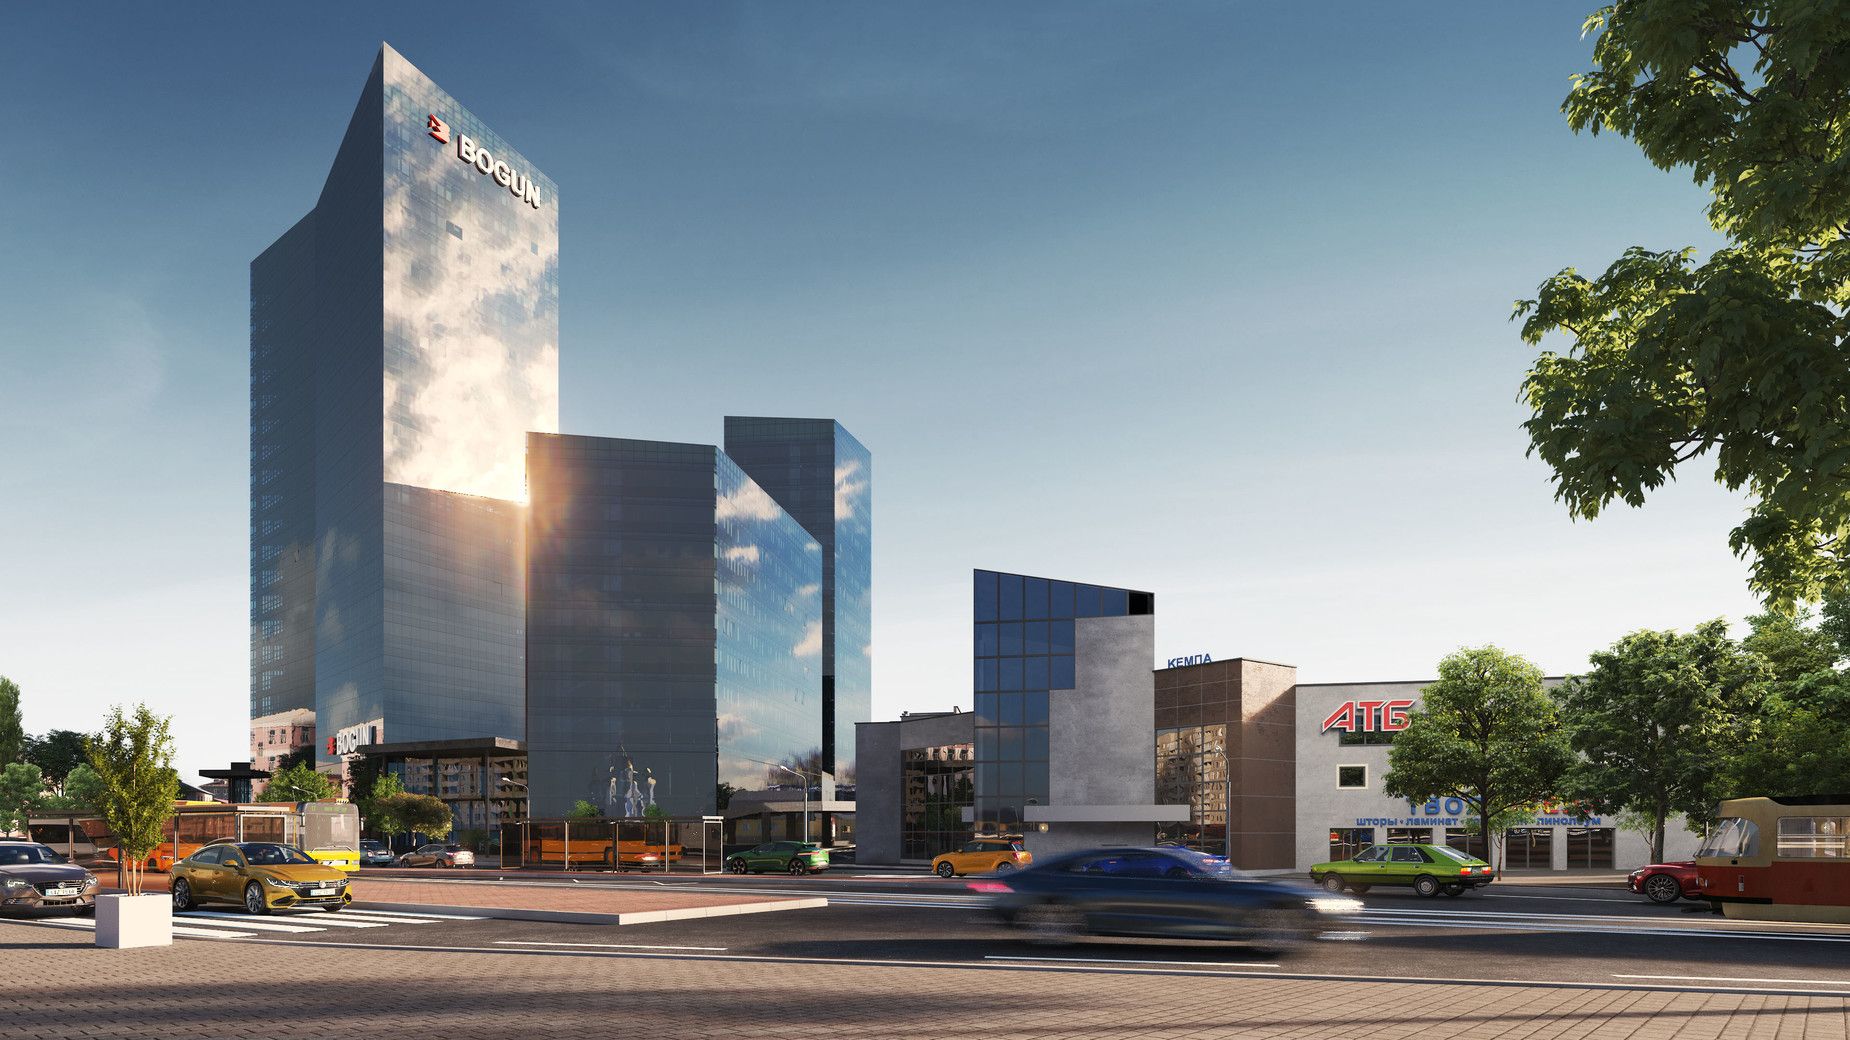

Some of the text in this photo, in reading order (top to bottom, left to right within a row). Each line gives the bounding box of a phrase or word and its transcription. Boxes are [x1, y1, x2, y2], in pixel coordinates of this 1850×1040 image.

[457, 132, 541, 209] BOGUN
[1167, 653, 1212, 669] КЕМПА
[1322, 699, 1415, 733] АТБ
[336, 726, 376, 755] BOGUN
[1356, 818, 1397, 828] шторы
[1405, 818, 1458, 826] ламинат
